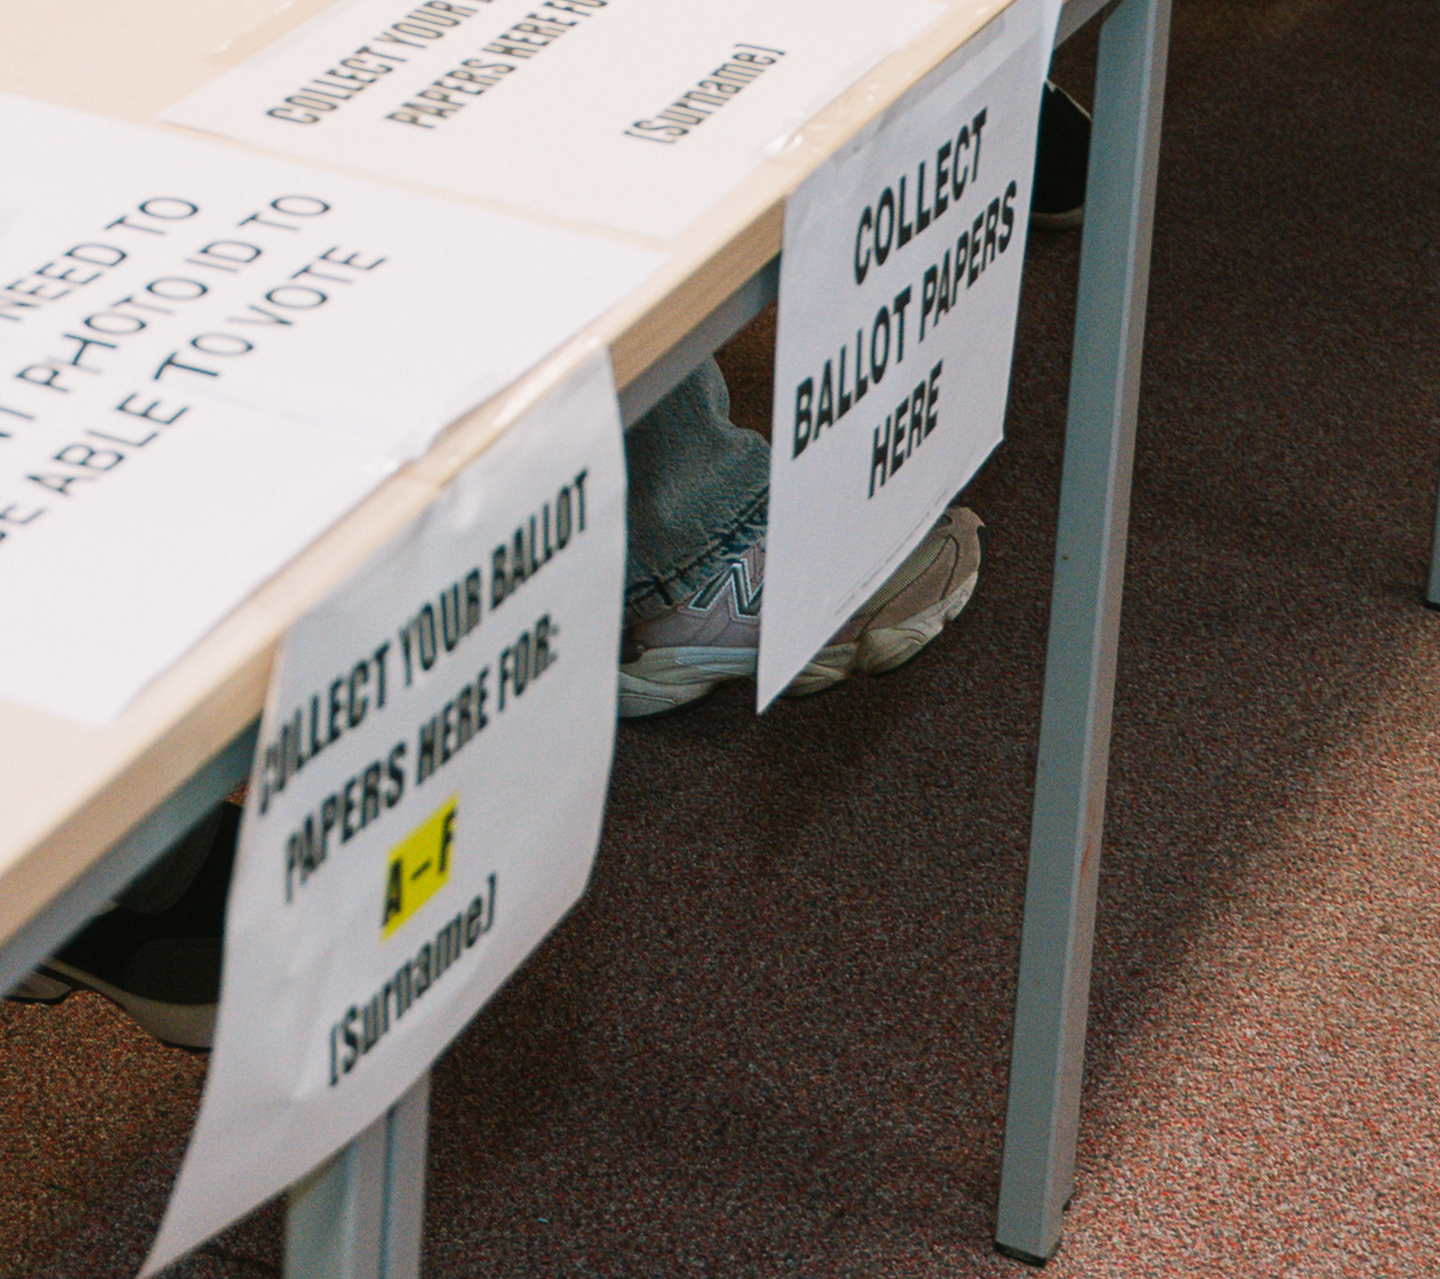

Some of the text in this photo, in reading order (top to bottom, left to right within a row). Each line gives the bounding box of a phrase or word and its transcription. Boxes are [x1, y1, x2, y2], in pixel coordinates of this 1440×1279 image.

[266, 46, 407, 125] COLLECT
[374, 0, 479, 49] YOUR
[385, 58, 516, 129] PAPERS
[482, 13, 579, 59] HERE
[125, 194, 201, 237] TO
[853, 106, 988, 285] COLLECT
[15, 274, 212, 394] PHOTO
[200, 238, 264, 273] ID
[239, 193, 334, 237] TO
[26, 392, 192, 501] ABLE
[153, 331, 256, 384] TO
[229, 245, 389, 334] VOTE
[793, 179, 1017, 461] BALLOT PAPERS
[868, 358, 943, 499] HERE
[259, 468, 590, 816] COLLECT YOUR BALLOT
[283, 611, 560, 904] PAPERS HERE FOR:
